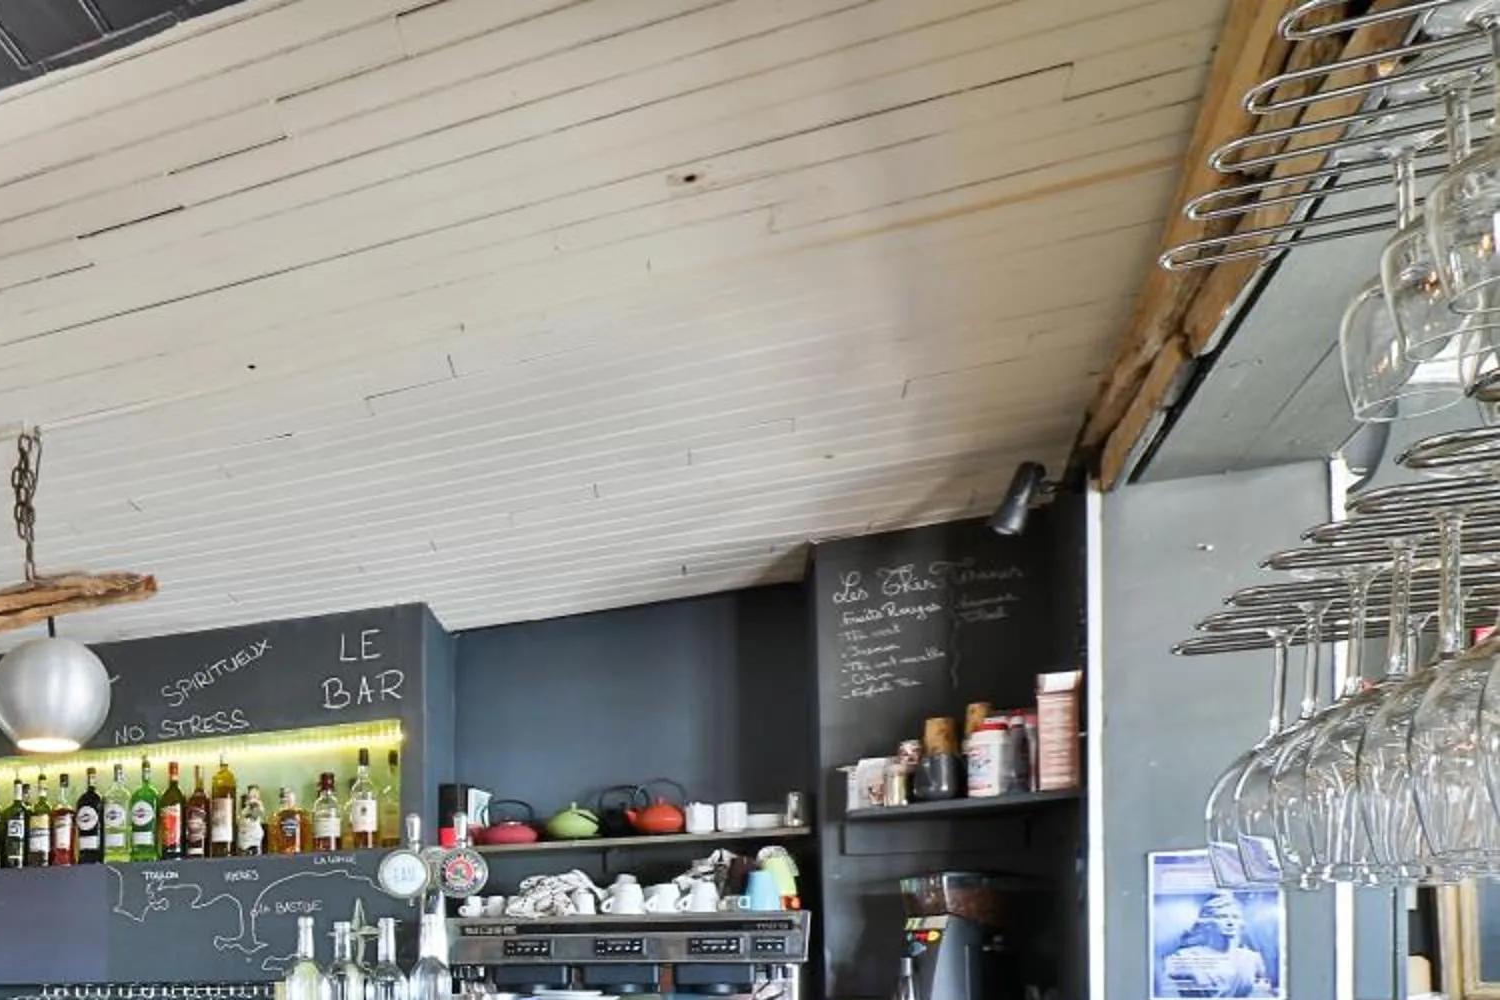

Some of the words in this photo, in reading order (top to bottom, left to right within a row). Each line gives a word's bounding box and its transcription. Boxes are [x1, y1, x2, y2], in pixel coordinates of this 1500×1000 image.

[339, 628, 382, 662] LE
[161, 638, 272, 707] SPIRITUEUX
[321, 669, 405, 709] BAR
[115, 725, 145, 745] NO
[157, 709, 250, 739] STRESS
